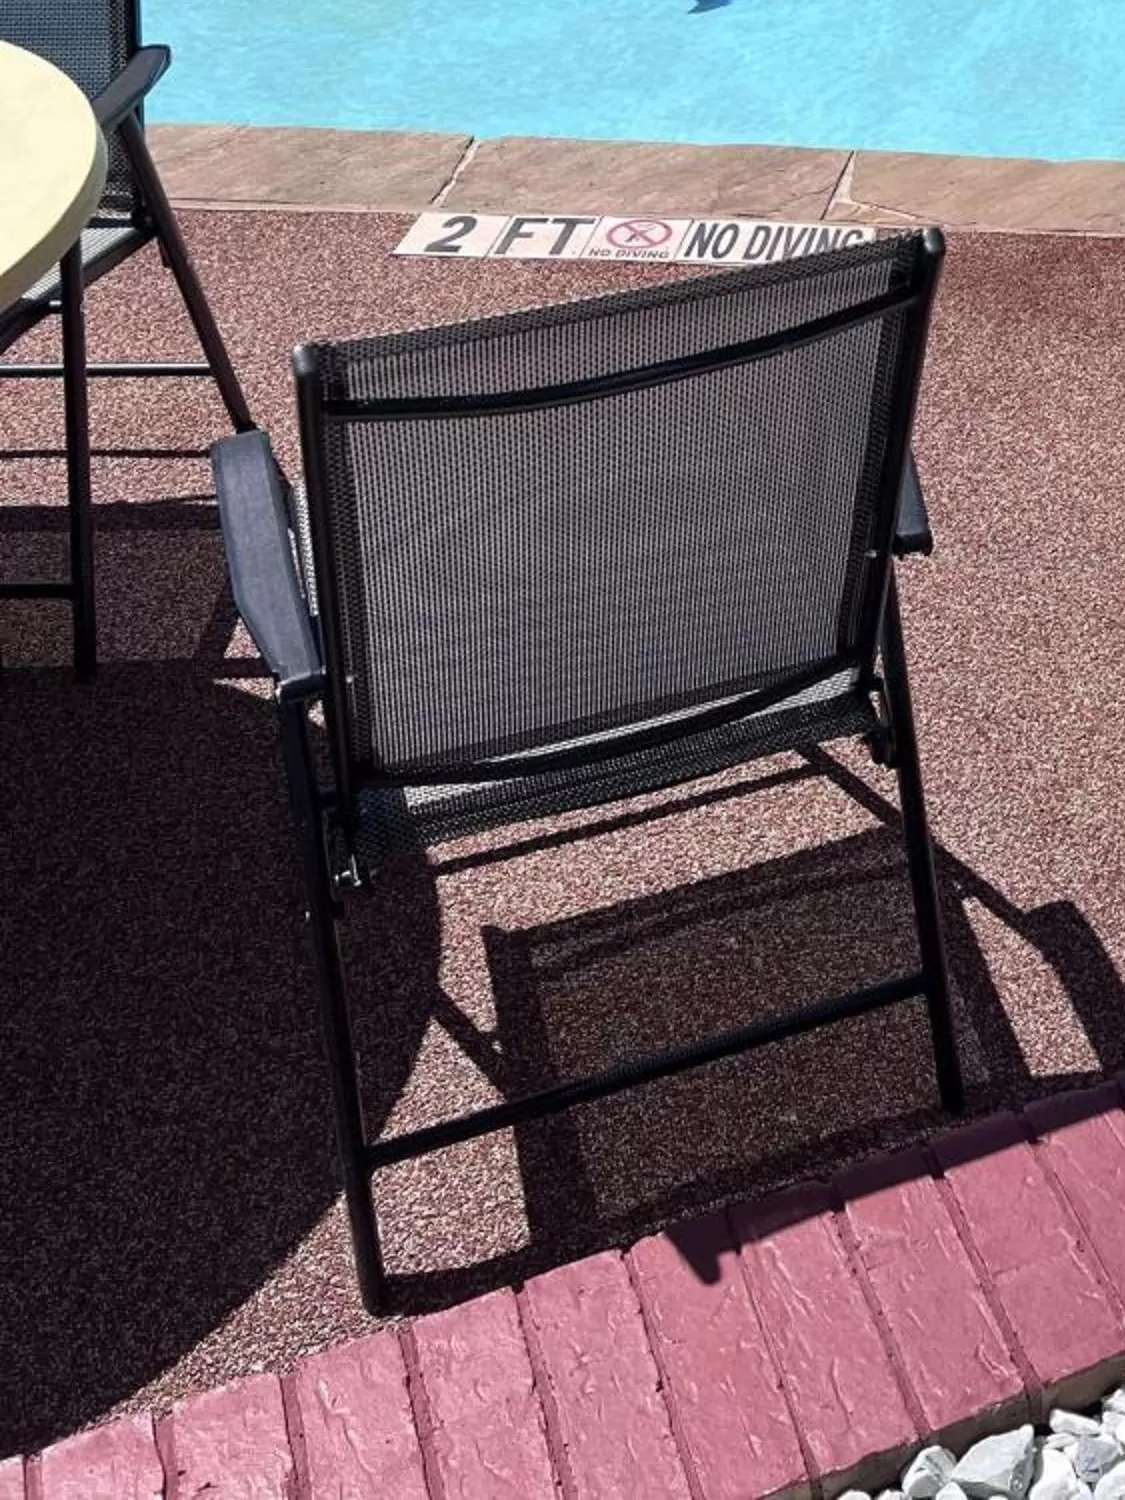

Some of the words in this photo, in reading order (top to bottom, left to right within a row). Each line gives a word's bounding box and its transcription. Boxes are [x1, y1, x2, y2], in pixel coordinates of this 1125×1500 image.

[423, 216, 478, 253] 2
[493, 217, 597, 255] FT
[588, 248, 611, 257] NO
[615, 249, 669, 260] DIVING
[683, 222, 740, 259] NO
